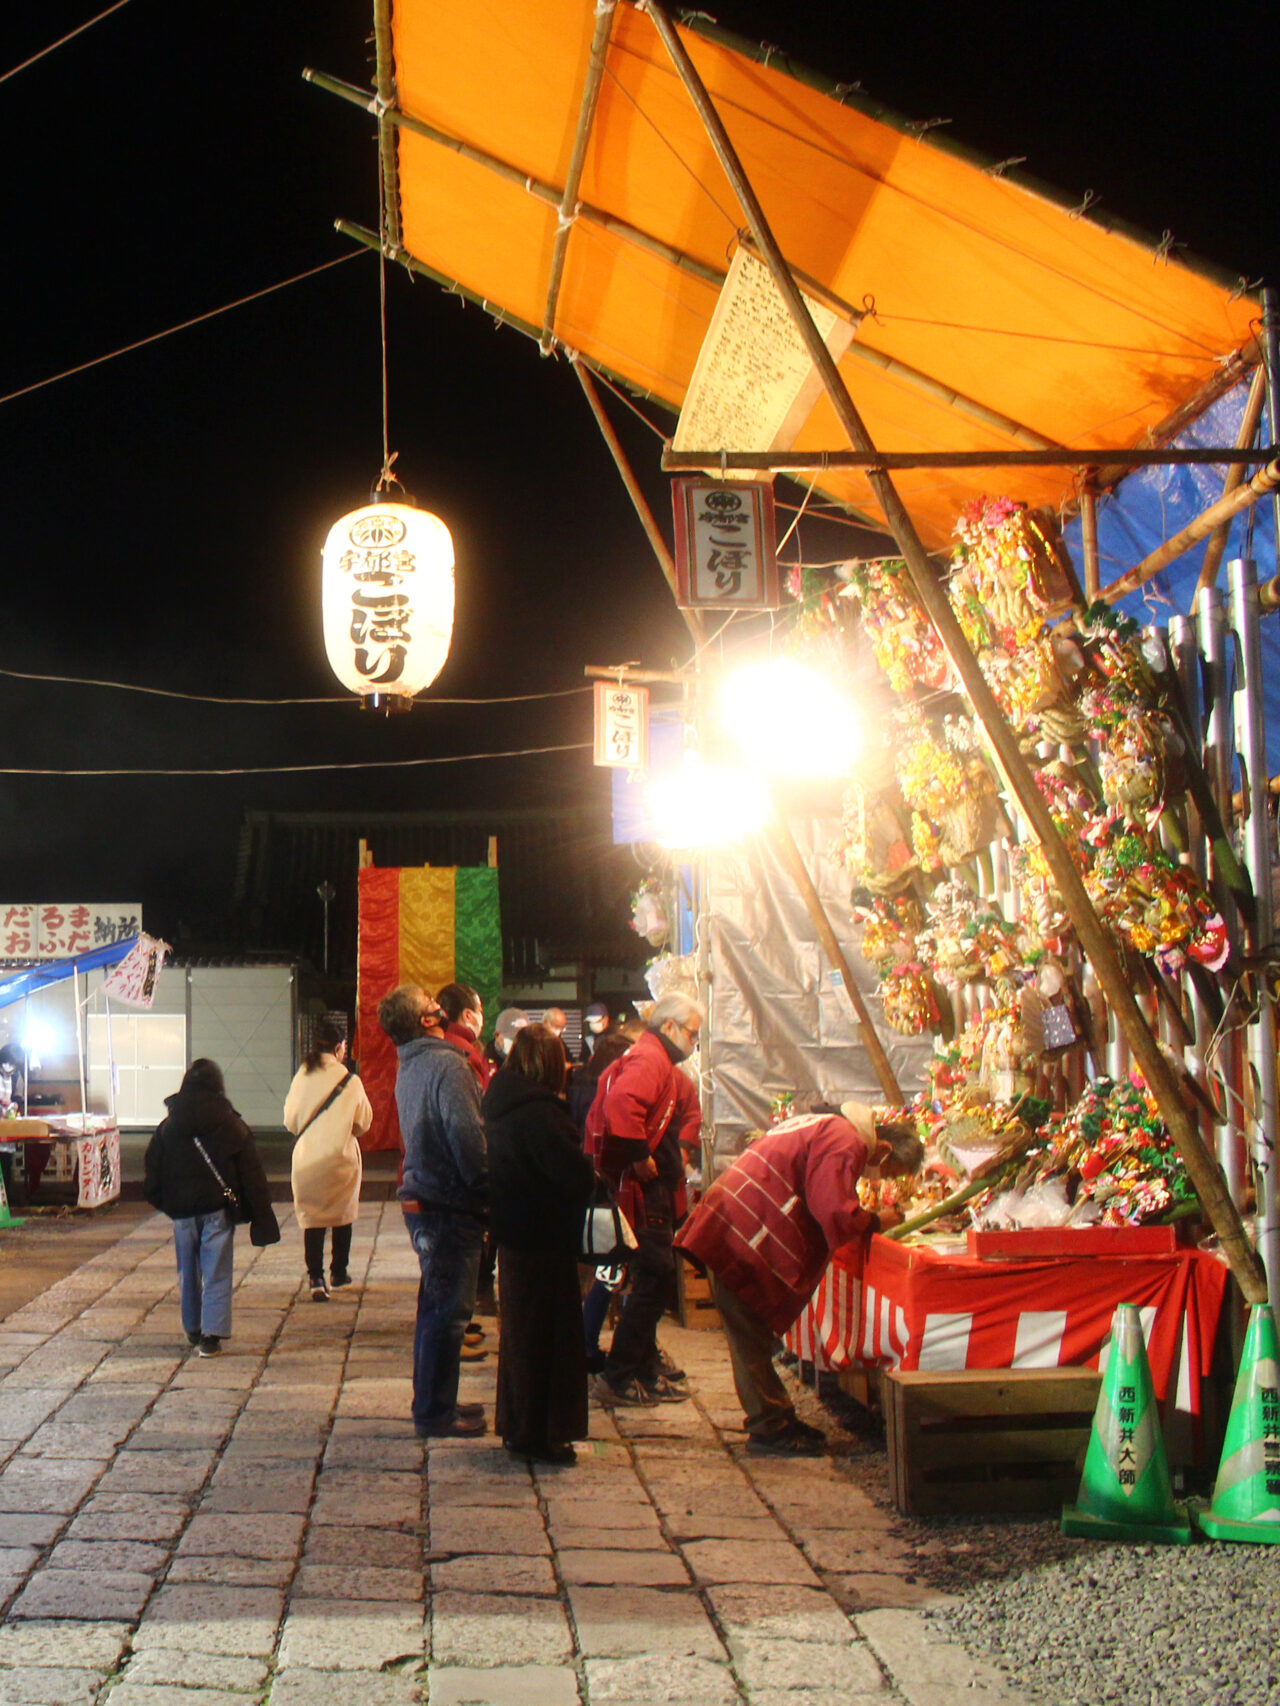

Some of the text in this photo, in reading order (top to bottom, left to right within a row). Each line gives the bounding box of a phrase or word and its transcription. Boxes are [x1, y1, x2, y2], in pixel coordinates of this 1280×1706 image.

[350, 571, 414, 684] こぼり
[1119, 1386, 1136, 1486] 西新井大師
